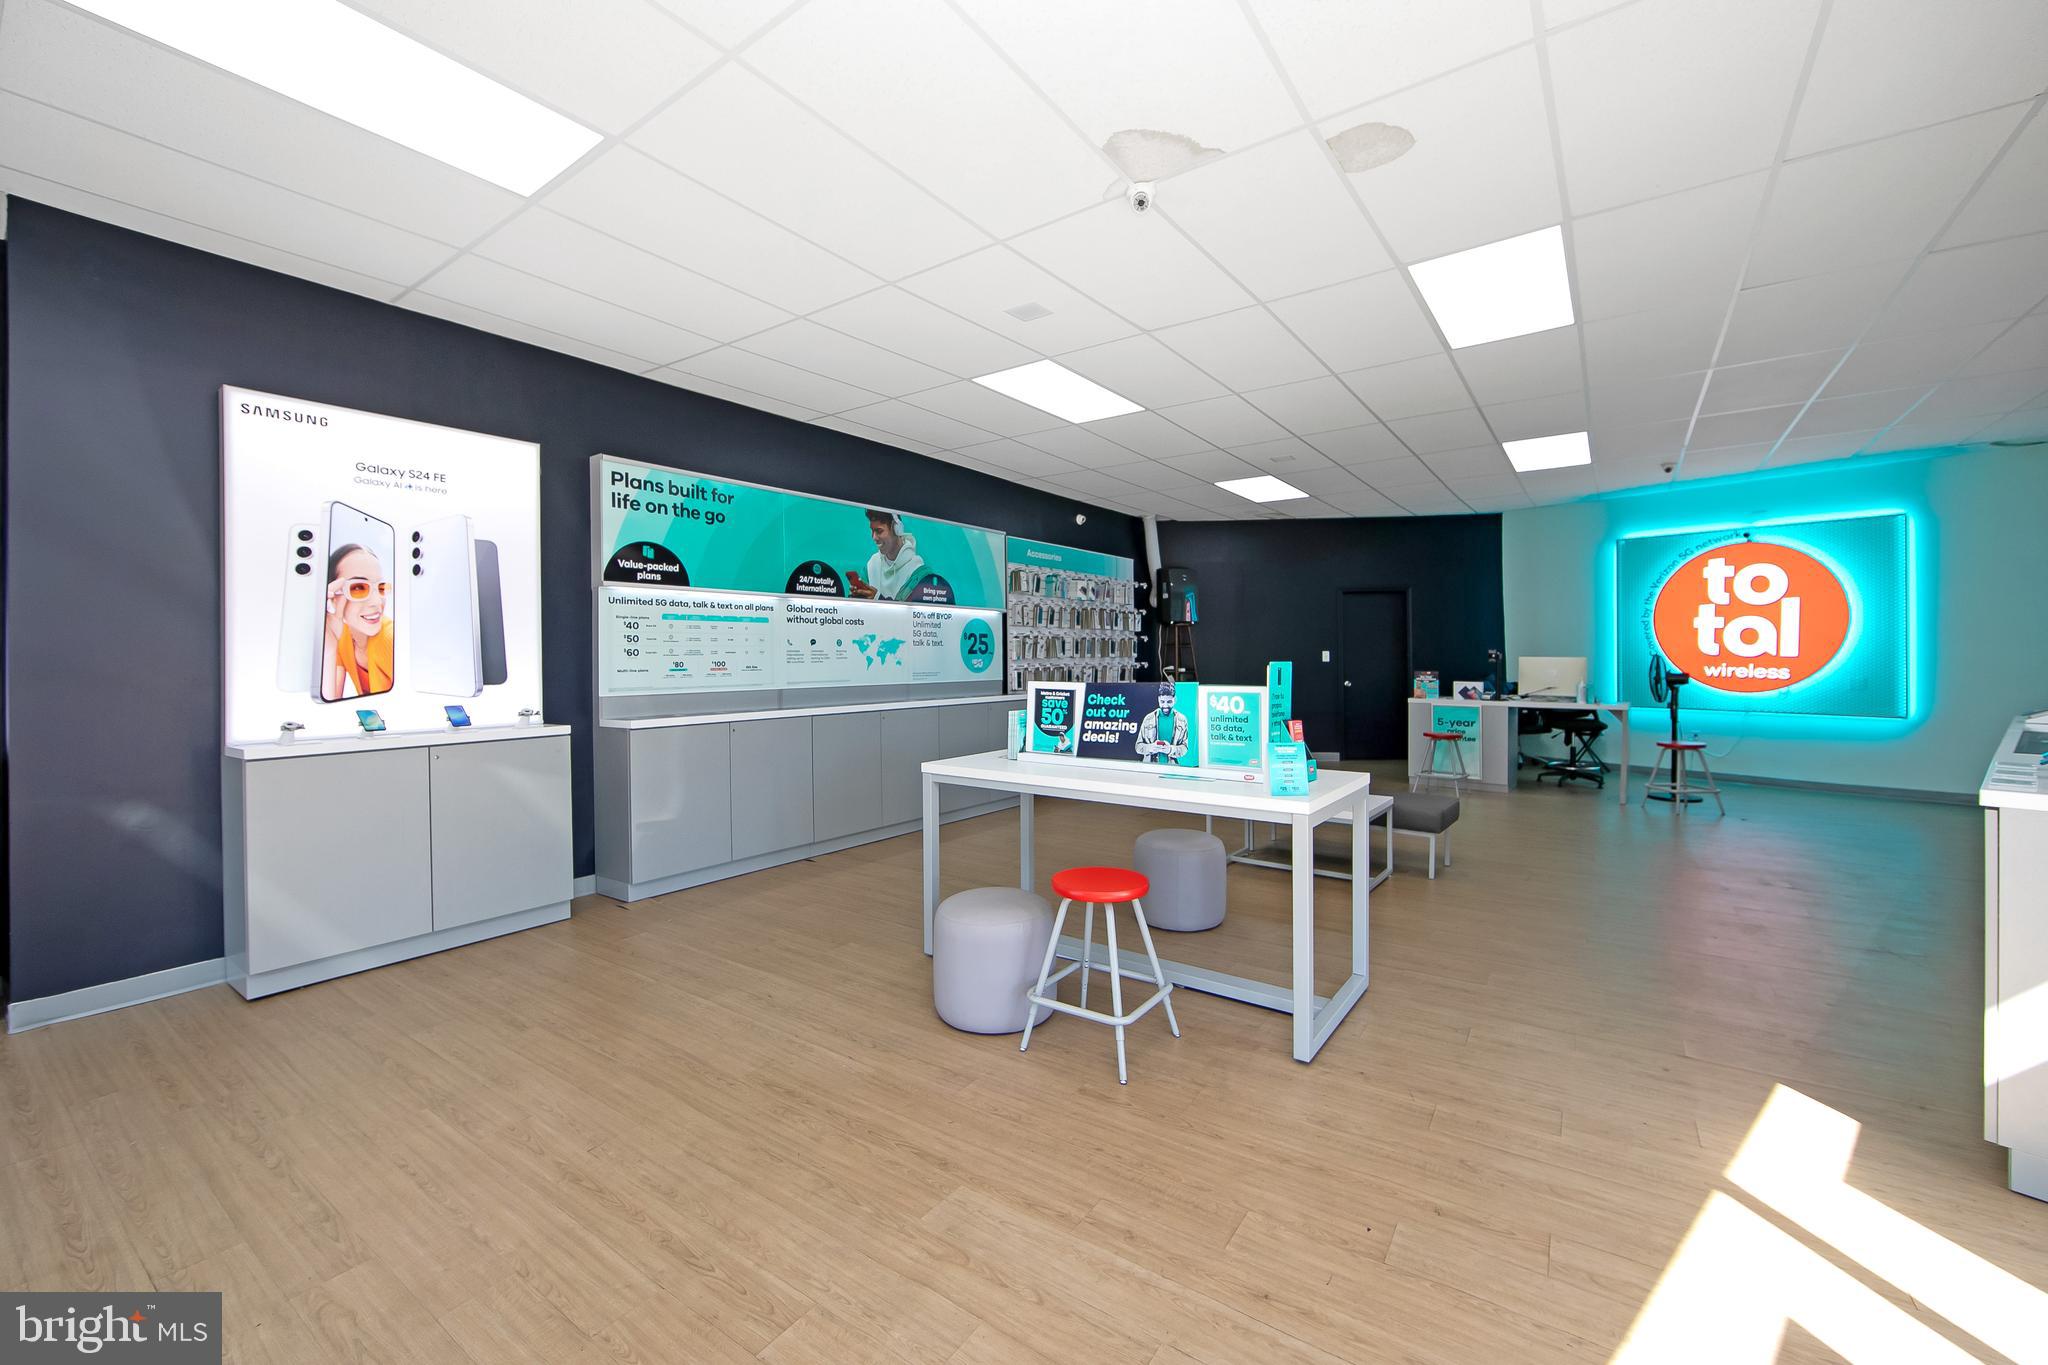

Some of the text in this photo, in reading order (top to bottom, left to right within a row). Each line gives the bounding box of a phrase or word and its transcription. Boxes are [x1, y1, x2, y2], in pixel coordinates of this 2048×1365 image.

[241, 402, 329, 428] SAMSUNG
[355, 461, 447, 483] Galaxy S24 FE
[353, 475, 390, 490] Galaxy
[611, 471, 734, 505] Plans built for
[611, 492, 726, 525] life on the go
[1027, 549, 1062, 562] Accessories
[1679, 547, 1694, 561] 5G
[617, 559, 679, 573] Value-packed
[637, 571, 661, 581] plans
[799, 575, 834, 587] 24/7 totally
[1703, 557, 1789, 606] to
[796, 584, 837, 594] international
[923, 587, 936, 595] Bring
[608, 596, 654, 606] Unlimited
[655, 599, 667, 607] 5G
[668, 599, 691, 609] data,
[692, 600, 708, 609] talk
[717, 602, 733, 610] text
[744, 603, 754, 611] all
[755, 604, 774, 612] plans
[786, 604, 838, 615] Global reach
[786, 615, 864, 627] without global costs
[912, 611, 926, 619] 50%
[927, 612, 936, 620] off
[623, 621, 640, 630] $40
[912, 621, 941, 629] Unlimited
[1693, 596, 1801, 657] tal
[623, 634, 640, 643] $50
[912, 630, 921, 638] 5G
[912, 639, 925, 647] talk
[963, 632, 989, 655] $25
[623, 648, 640, 657] $60
[1704, 662, 1791, 680] wireless
[1041, 699, 1068, 708] save
[1087, 693, 1126, 706] Check
[1210, 694, 1245, 714] $40
[1085, 707, 1130, 719] out our
[1210, 715, 1249, 723] unlimited
[1084, 718, 1138, 734] amazing
[1437, 717, 1477, 728] 5-year
[1223, 725, 1245, 733] data,
[1082, 731, 1120, 743] deals!
[1210, 733, 1226, 741] talk
[1235, 734, 1253, 742] text
